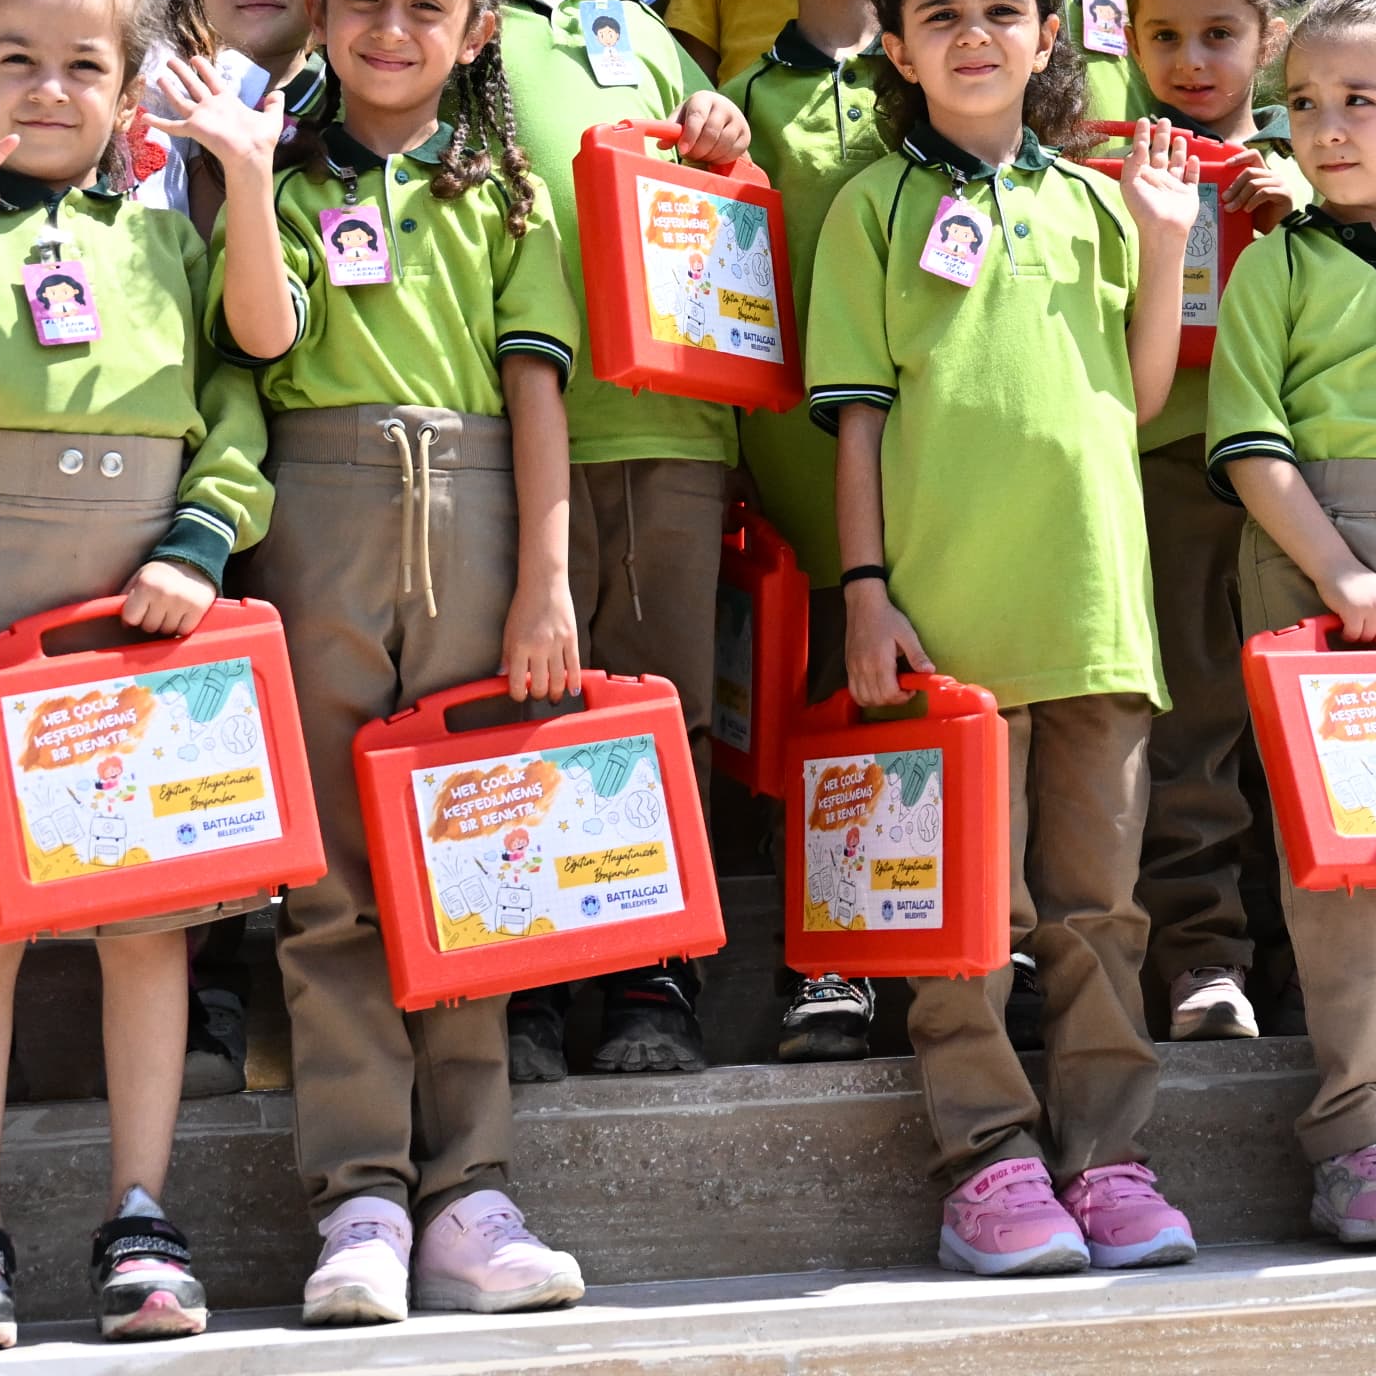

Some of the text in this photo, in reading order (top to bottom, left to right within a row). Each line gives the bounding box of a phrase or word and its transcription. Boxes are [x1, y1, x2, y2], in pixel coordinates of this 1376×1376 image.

[42, 696, 119, 727] HER ÇOCUK
[450, 771, 526, 799] HER ÇOCUK
[443, 782, 543, 820] KEŞFEDİLMEMİŞ
